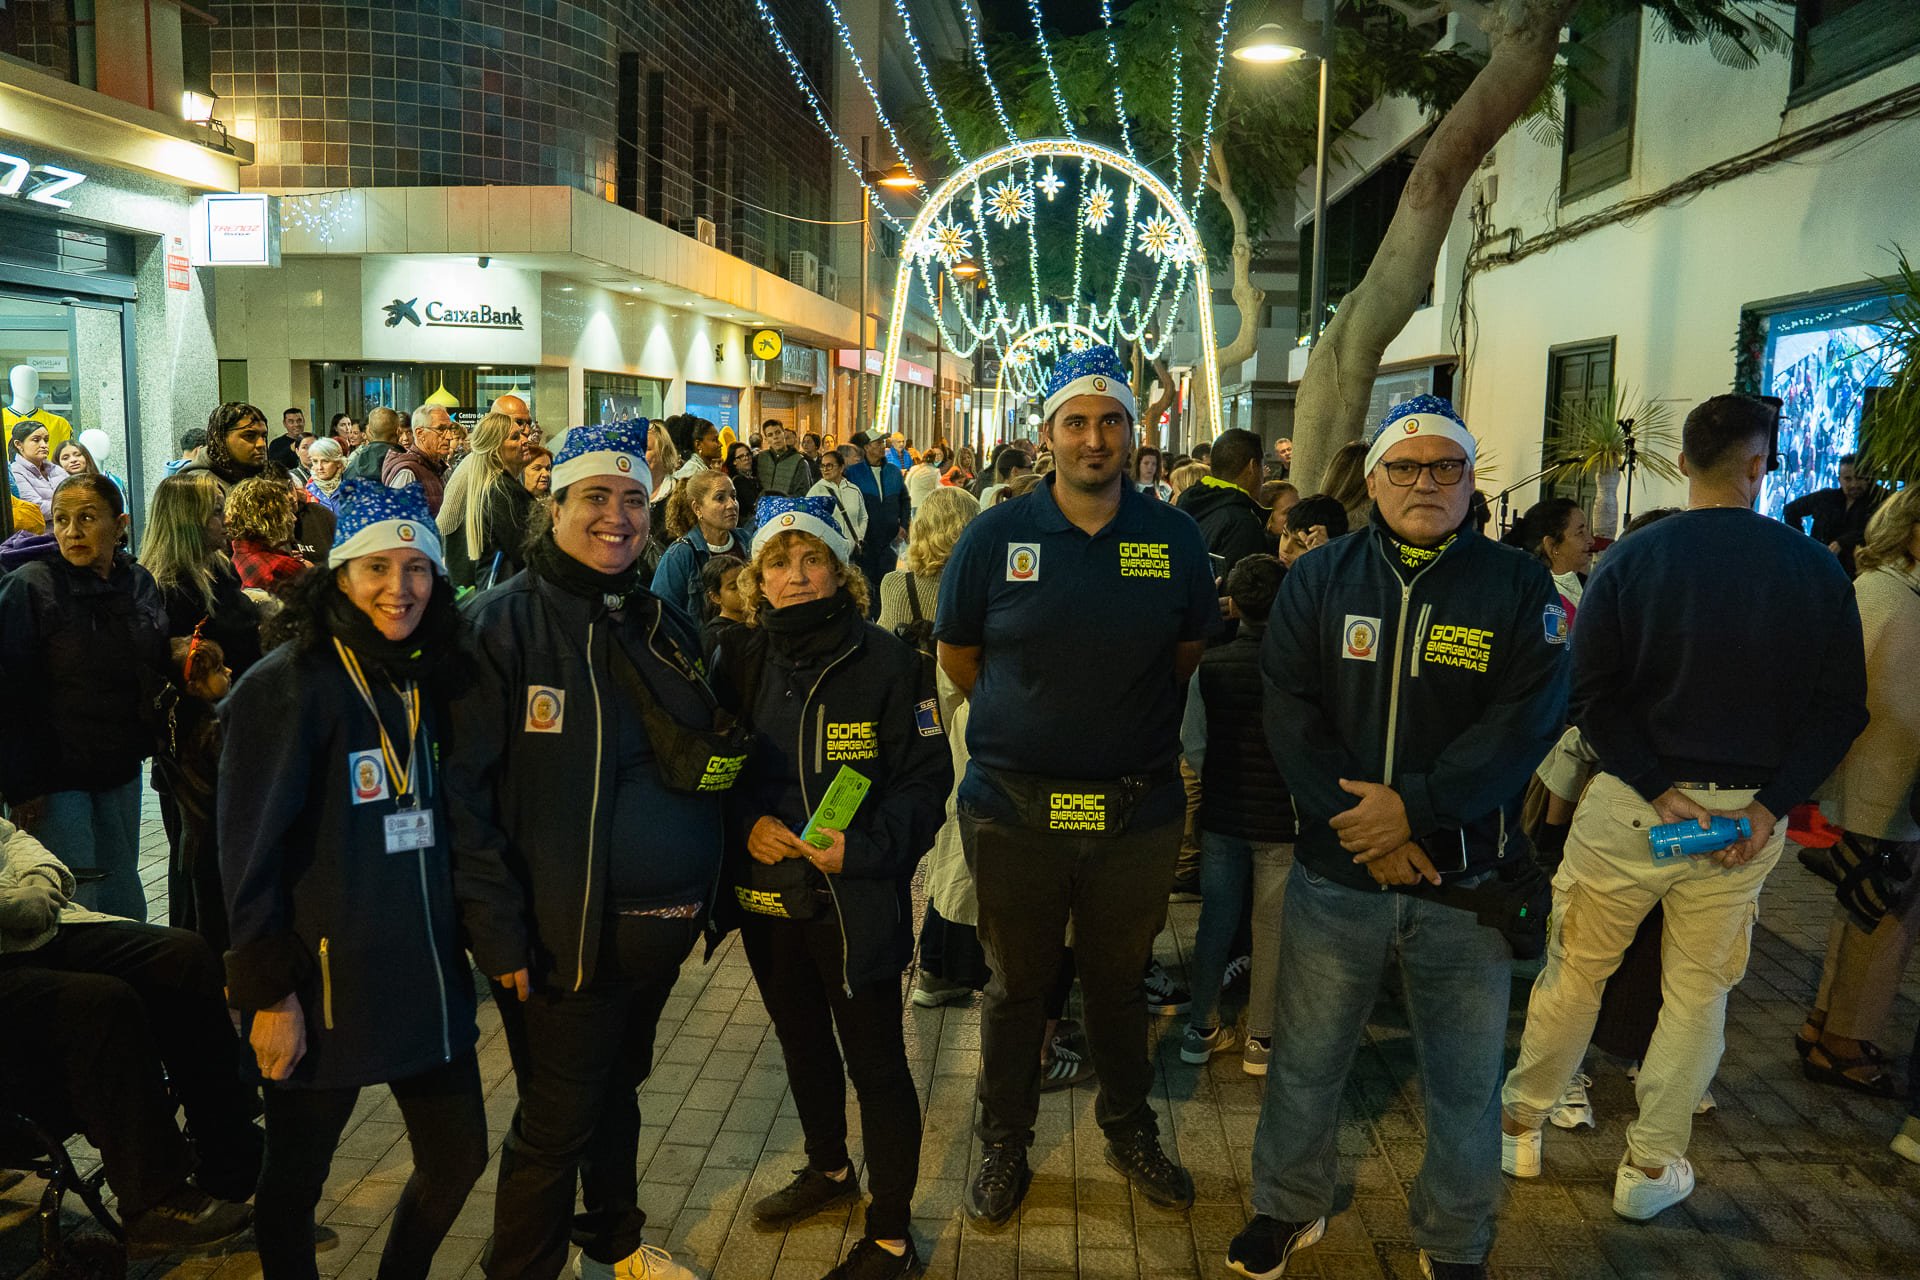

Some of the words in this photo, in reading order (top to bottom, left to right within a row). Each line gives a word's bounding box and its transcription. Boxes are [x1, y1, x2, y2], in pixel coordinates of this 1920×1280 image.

[425, 301, 524, 326] CaixaBank
[1119, 542, 1169, 559] GOREC
[1120, 558, 1170, 569] EMERGENCIAS
[1120, 568, 1171, 579] CANARIAS
[1430, 624, 1494, 650] GOREC
[1426, 641, 1490, 662] EMERGENCIAS
[1424, 652, 1488, 673] CANARIAS
[1050, 793, 1106, 810] GOREC
[1050, 810, 1106, 821] EMERGENCIAS
[1050, 820, 1106, 831] CANARIAS
